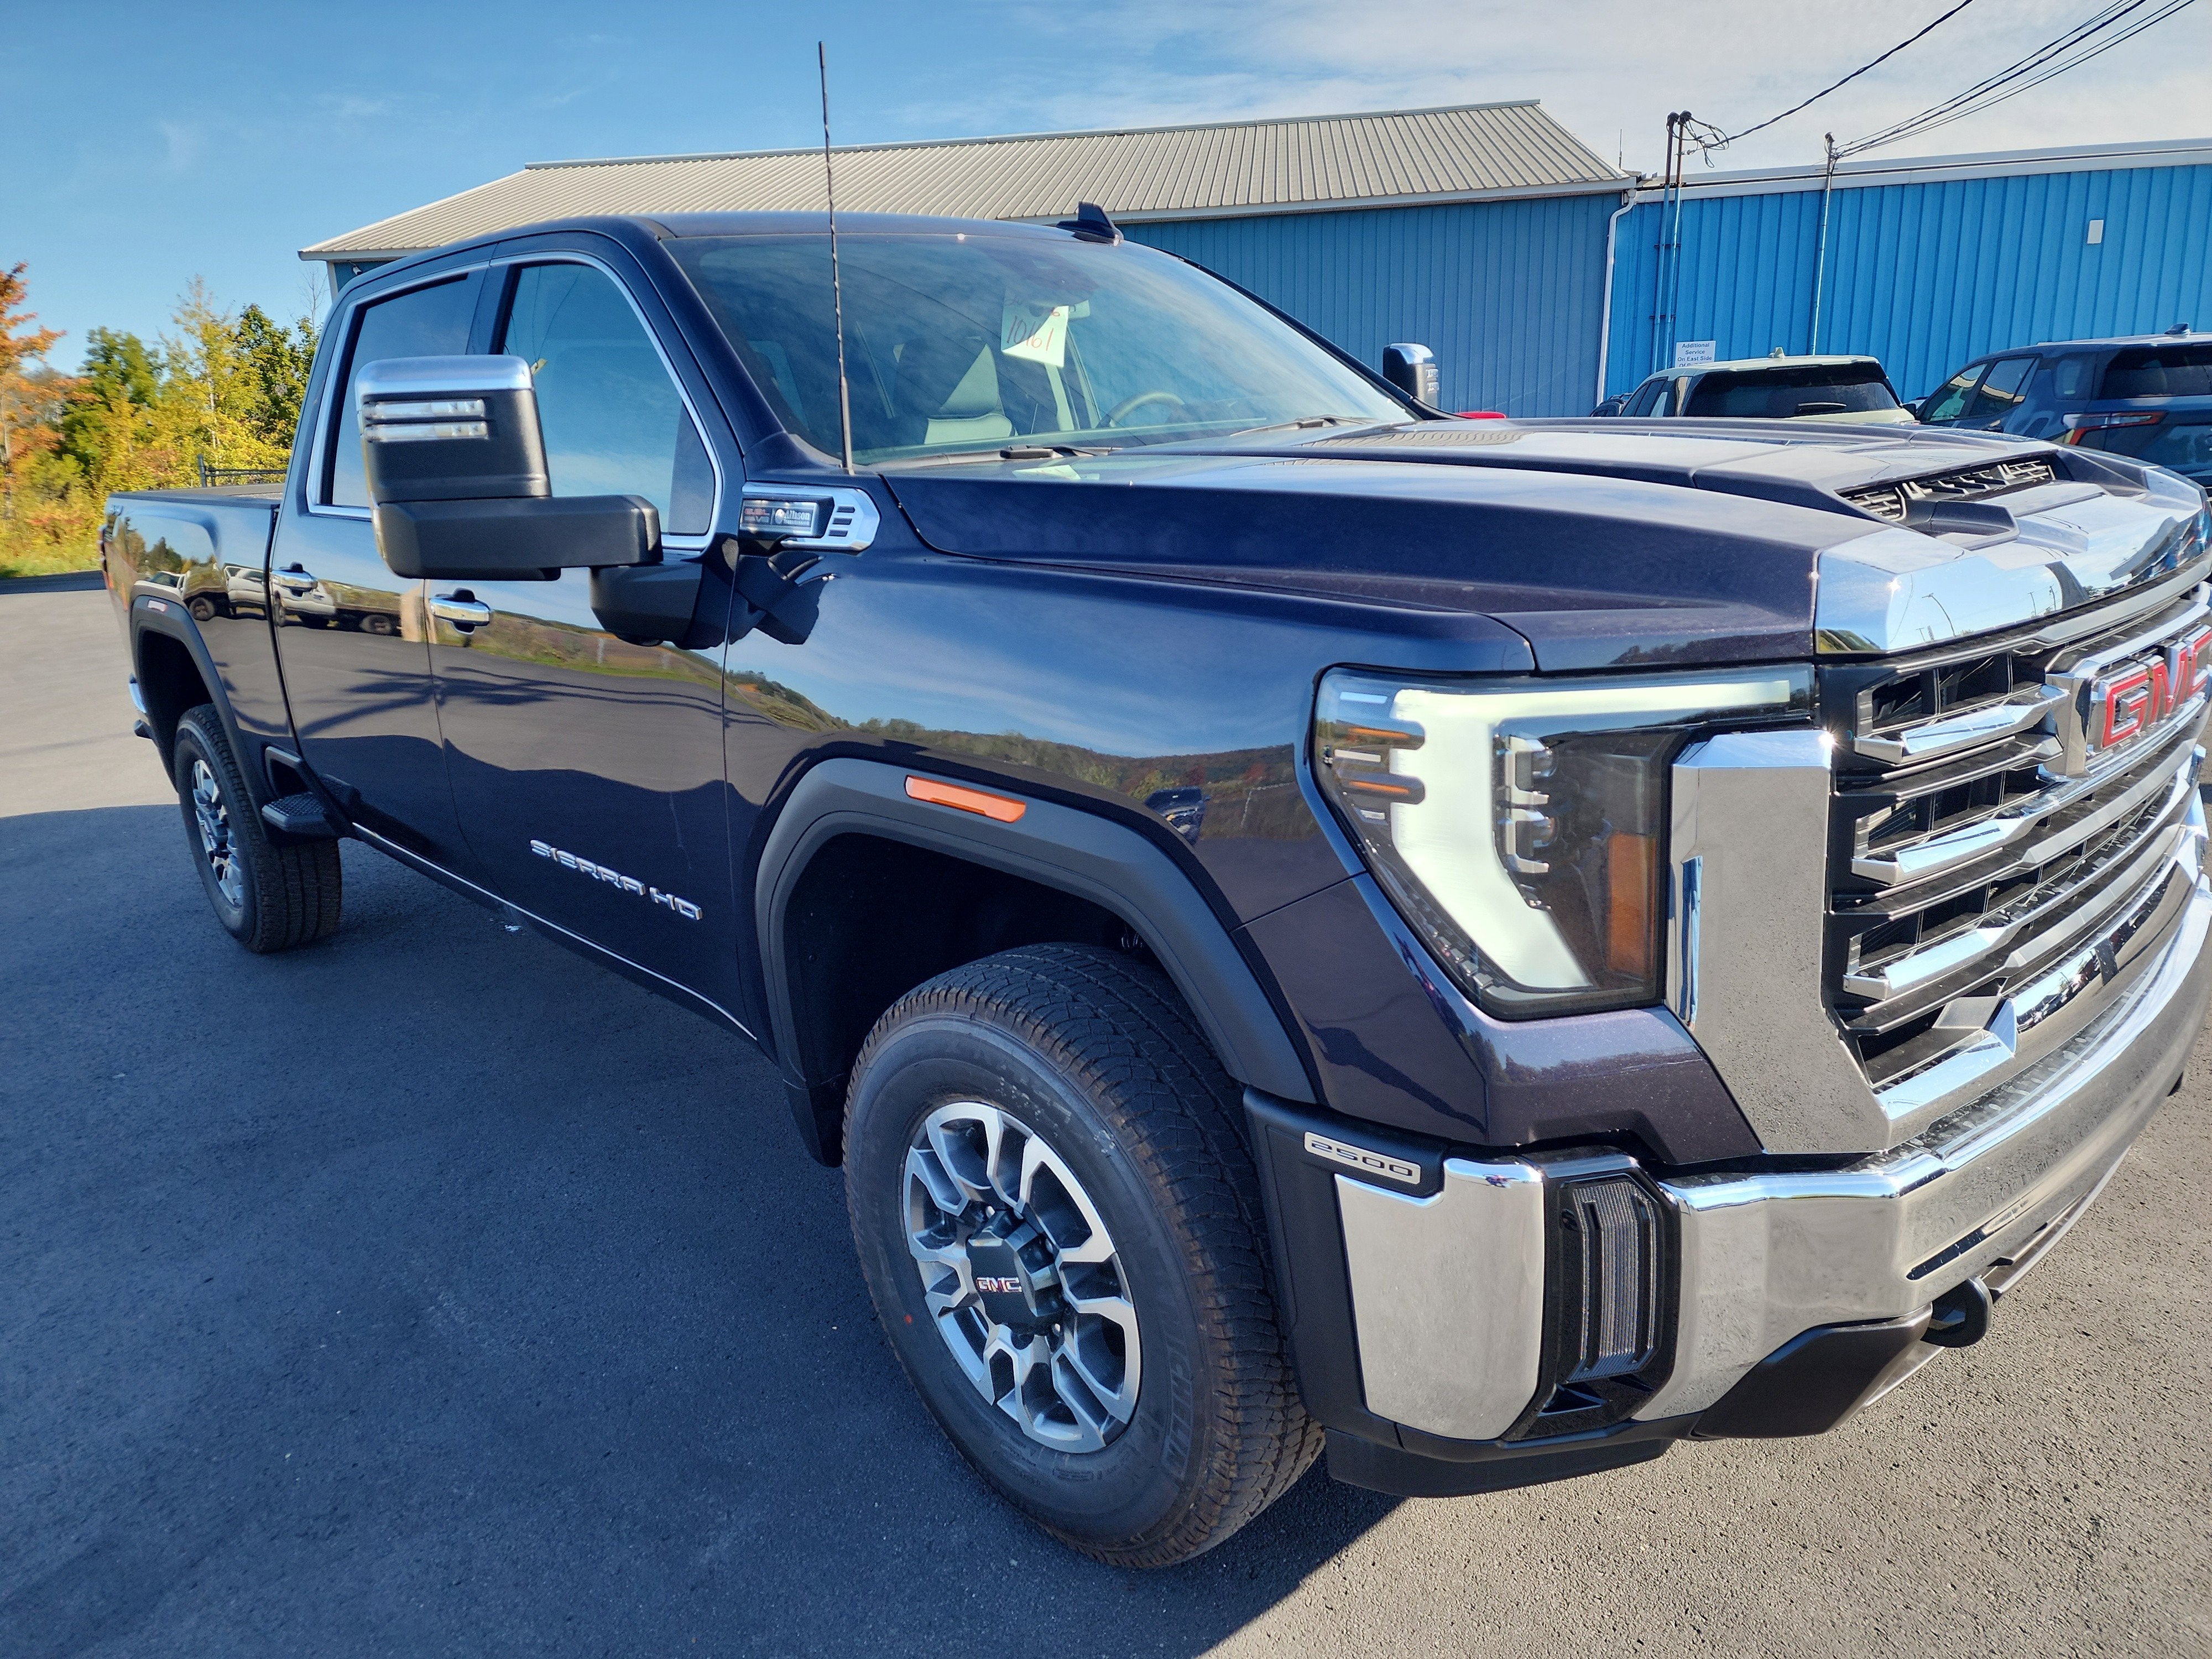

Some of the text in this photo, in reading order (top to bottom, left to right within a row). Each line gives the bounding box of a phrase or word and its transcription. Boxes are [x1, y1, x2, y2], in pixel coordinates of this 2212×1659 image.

[784, 510, 811, 520] Allison
[2100, 624, 2212, 749] GMC
[530, 839, 703, 920] SIERRA HD
[1311, 1140, 1413, 1177] 2500
[976, 1276, 1022, 1293] GMC
